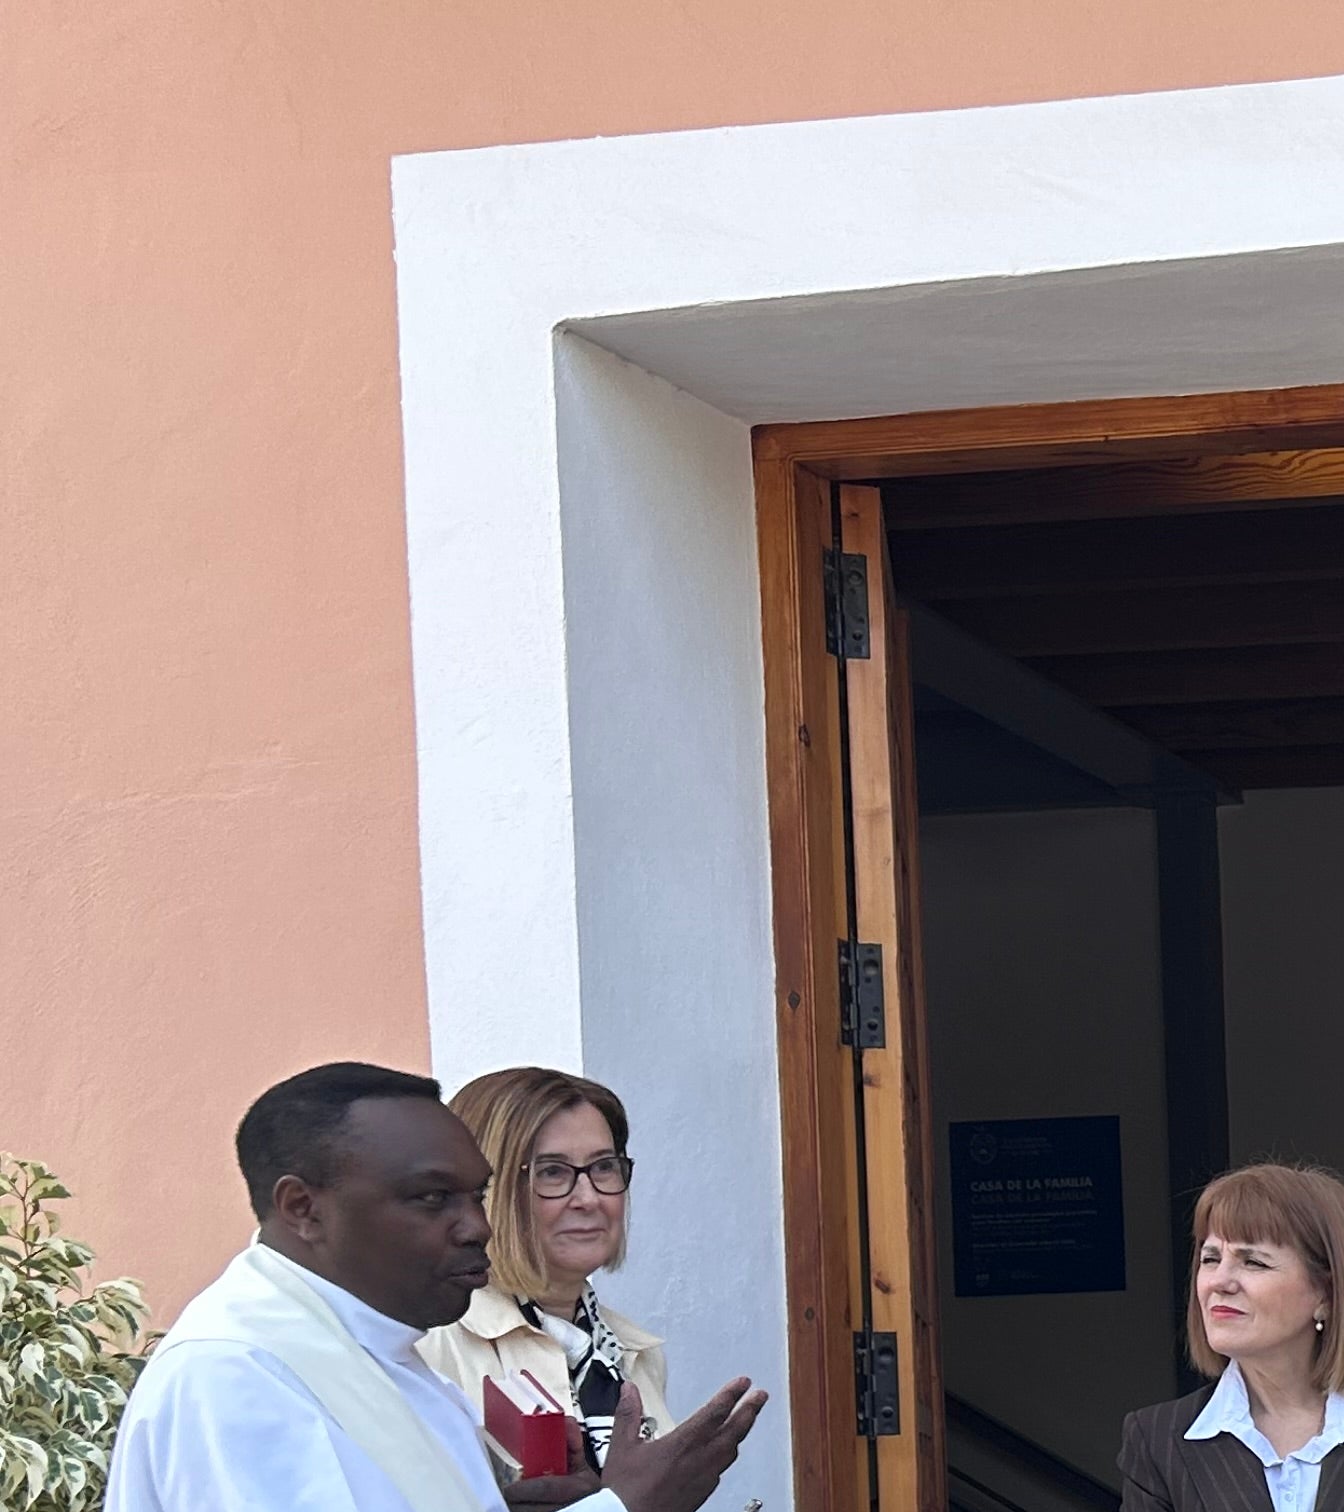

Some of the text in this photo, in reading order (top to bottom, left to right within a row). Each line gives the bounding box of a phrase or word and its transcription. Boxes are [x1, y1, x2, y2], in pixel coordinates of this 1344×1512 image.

[970, 1176, 1093, 1193] CASA DE LA FAMILIA
